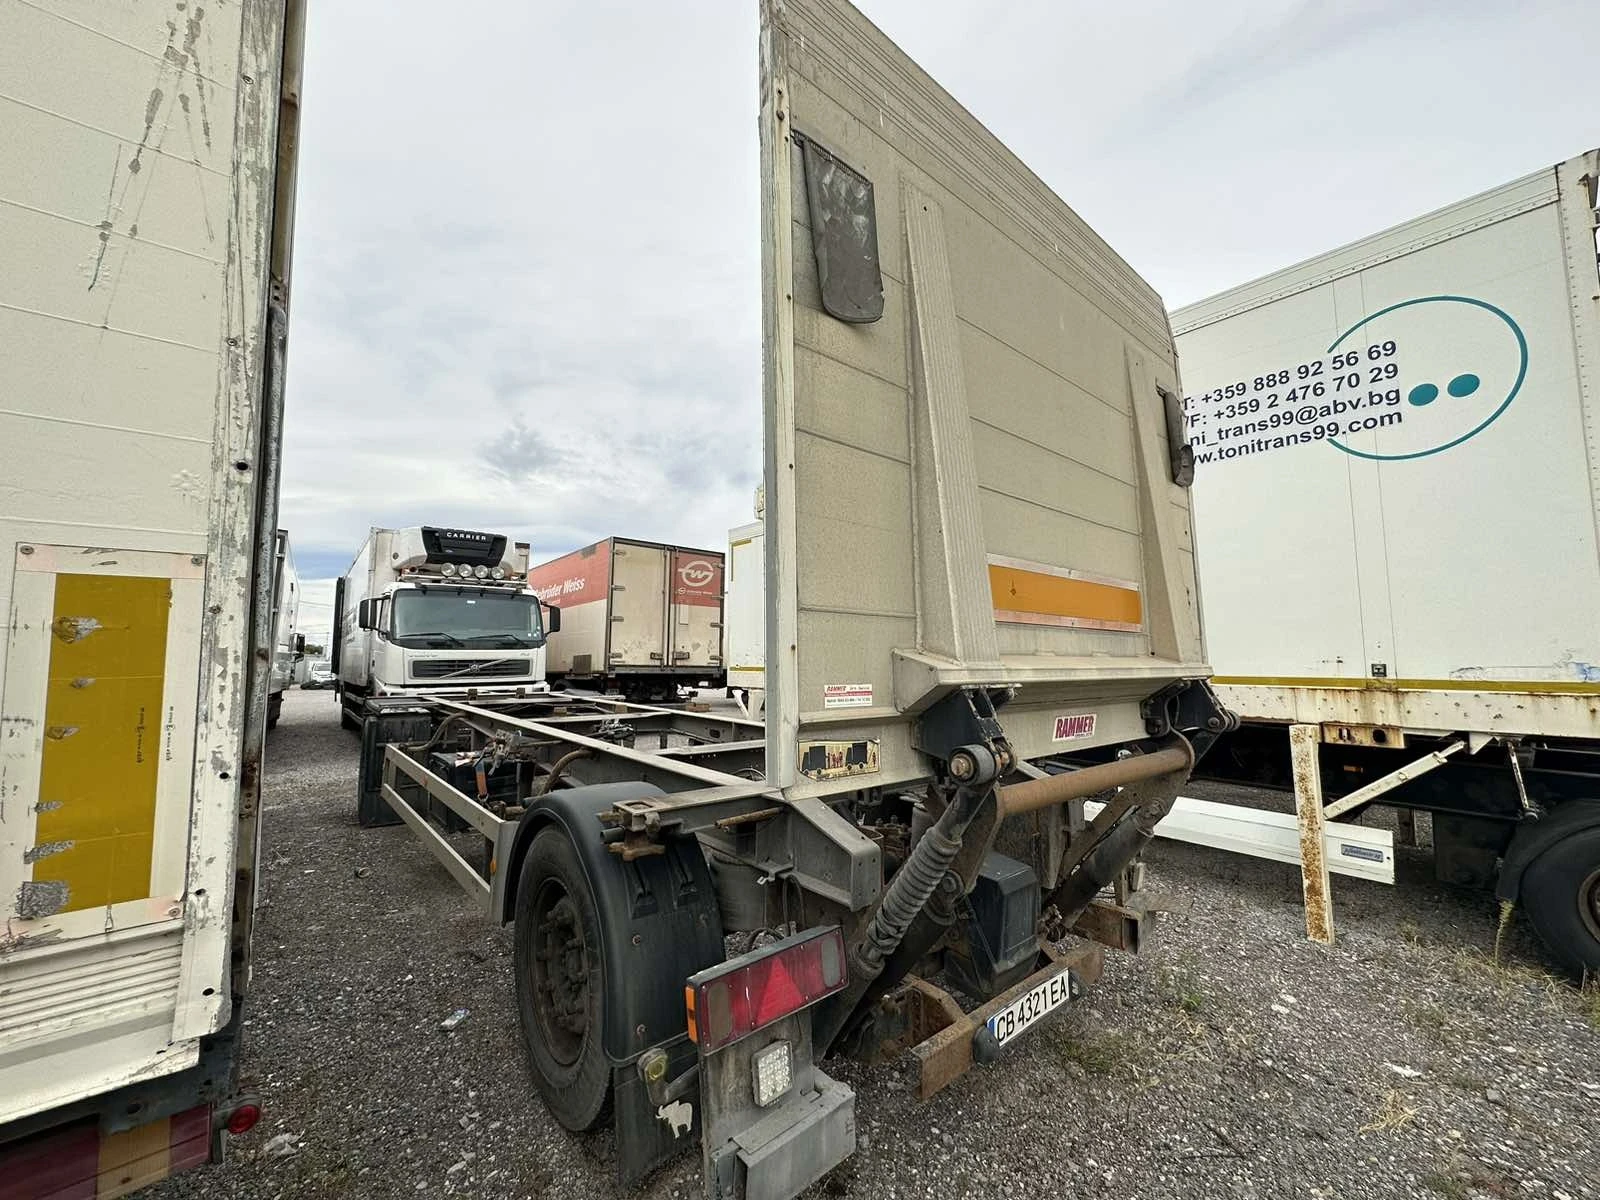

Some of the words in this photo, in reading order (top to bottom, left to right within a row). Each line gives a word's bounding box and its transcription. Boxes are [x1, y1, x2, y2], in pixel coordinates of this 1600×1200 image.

[1201, 382, 1247, 403] +359
[1253, 370, 1290, 391] 888
[1297, 360, 1324, 380] 92
[1331, 351, 1359, 370] 56
[1367, 340, 1397, 361] 69
[1214, 398, 1260, 419] +359
[1266, 393, 1279, 409] 2
[1285, 382, 1325, 402] 476
[1332, 372, 1360, 392] 70
[1368, 363, 1399, 384] 29
[446, 532, 486, 541] CARRIER
[536, 583, 561, 600] ebrüder
[562, 576, 585, 594] Weiss
[1055, 715, 1095, 739] RAMMER
[996, 1010, 1015, 1041] CB
[1017, 986, 1047, 1026] 4321
[1050, 975, 1068, 1005] EA
